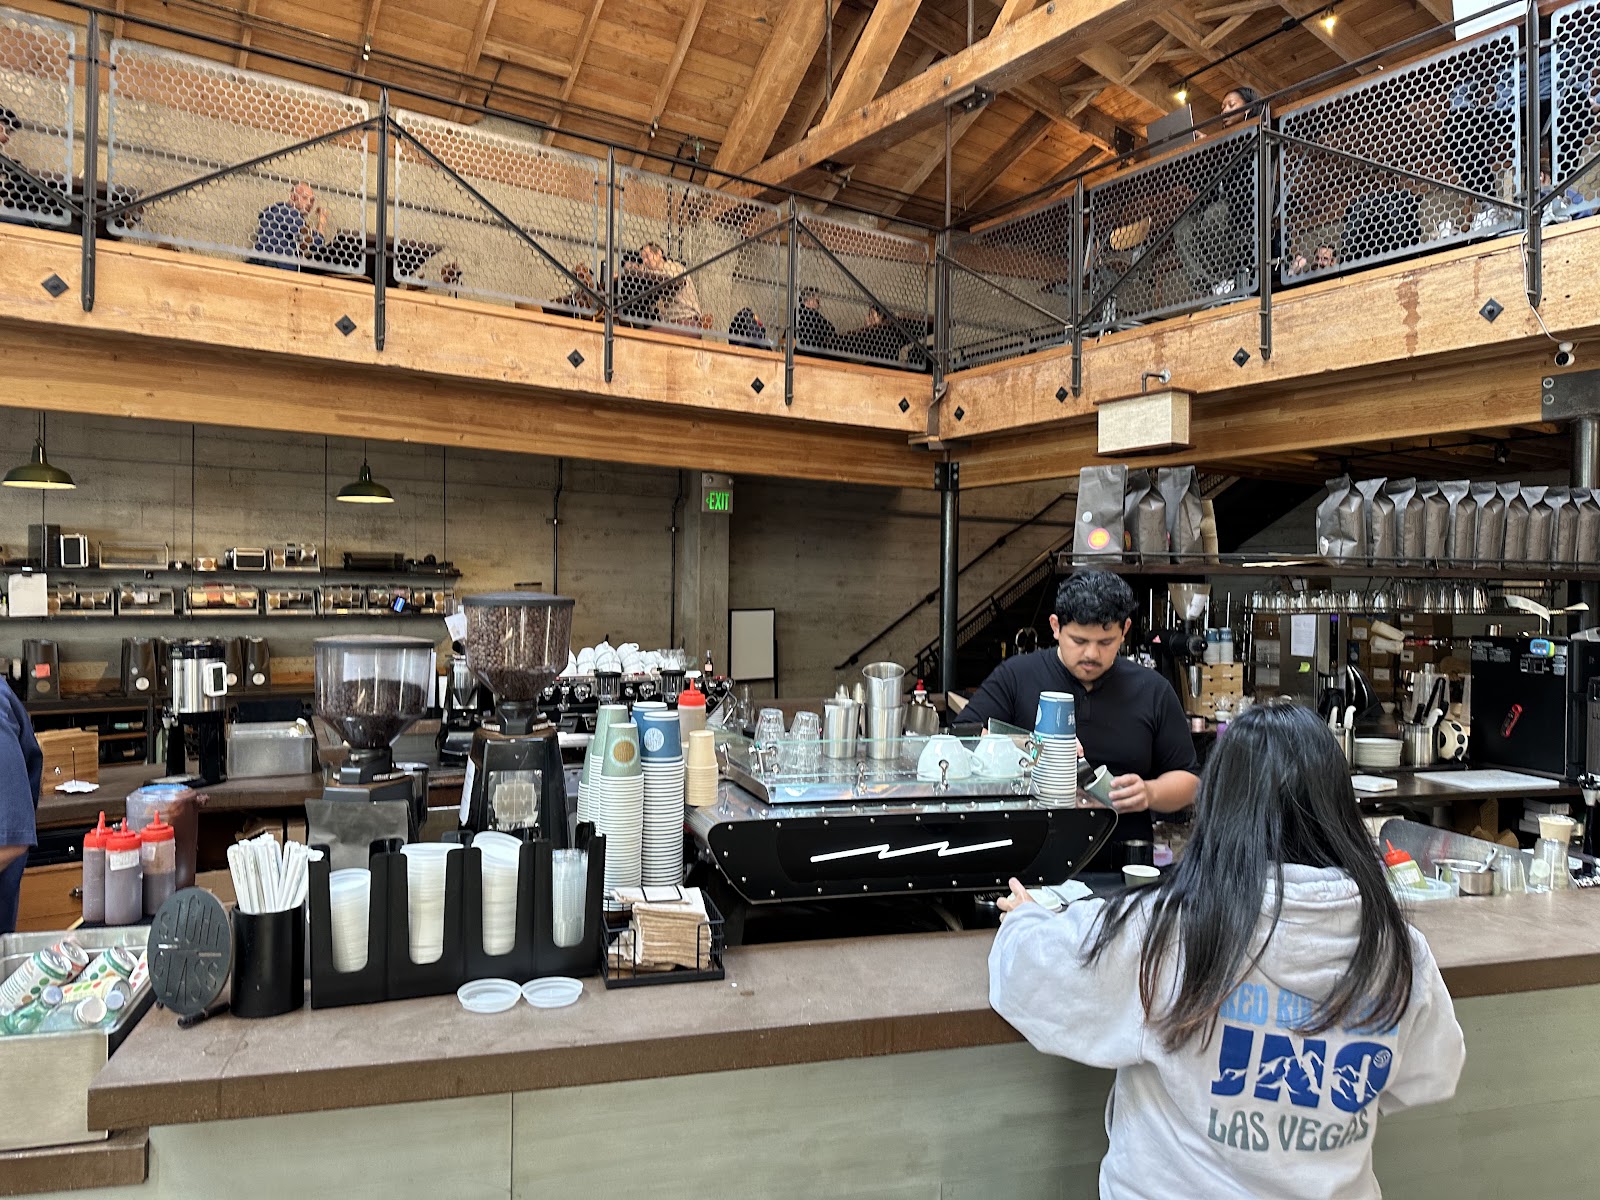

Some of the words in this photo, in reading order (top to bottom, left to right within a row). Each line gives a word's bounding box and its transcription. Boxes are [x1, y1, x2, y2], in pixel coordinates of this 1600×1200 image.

[709, 491, 730, 511] EXIT
[153, 949, 220, 1007] GLASS
[1207, 1106, 1270, 1152] LAS
[1278, 1105, 1369, 1152] VEGAS
